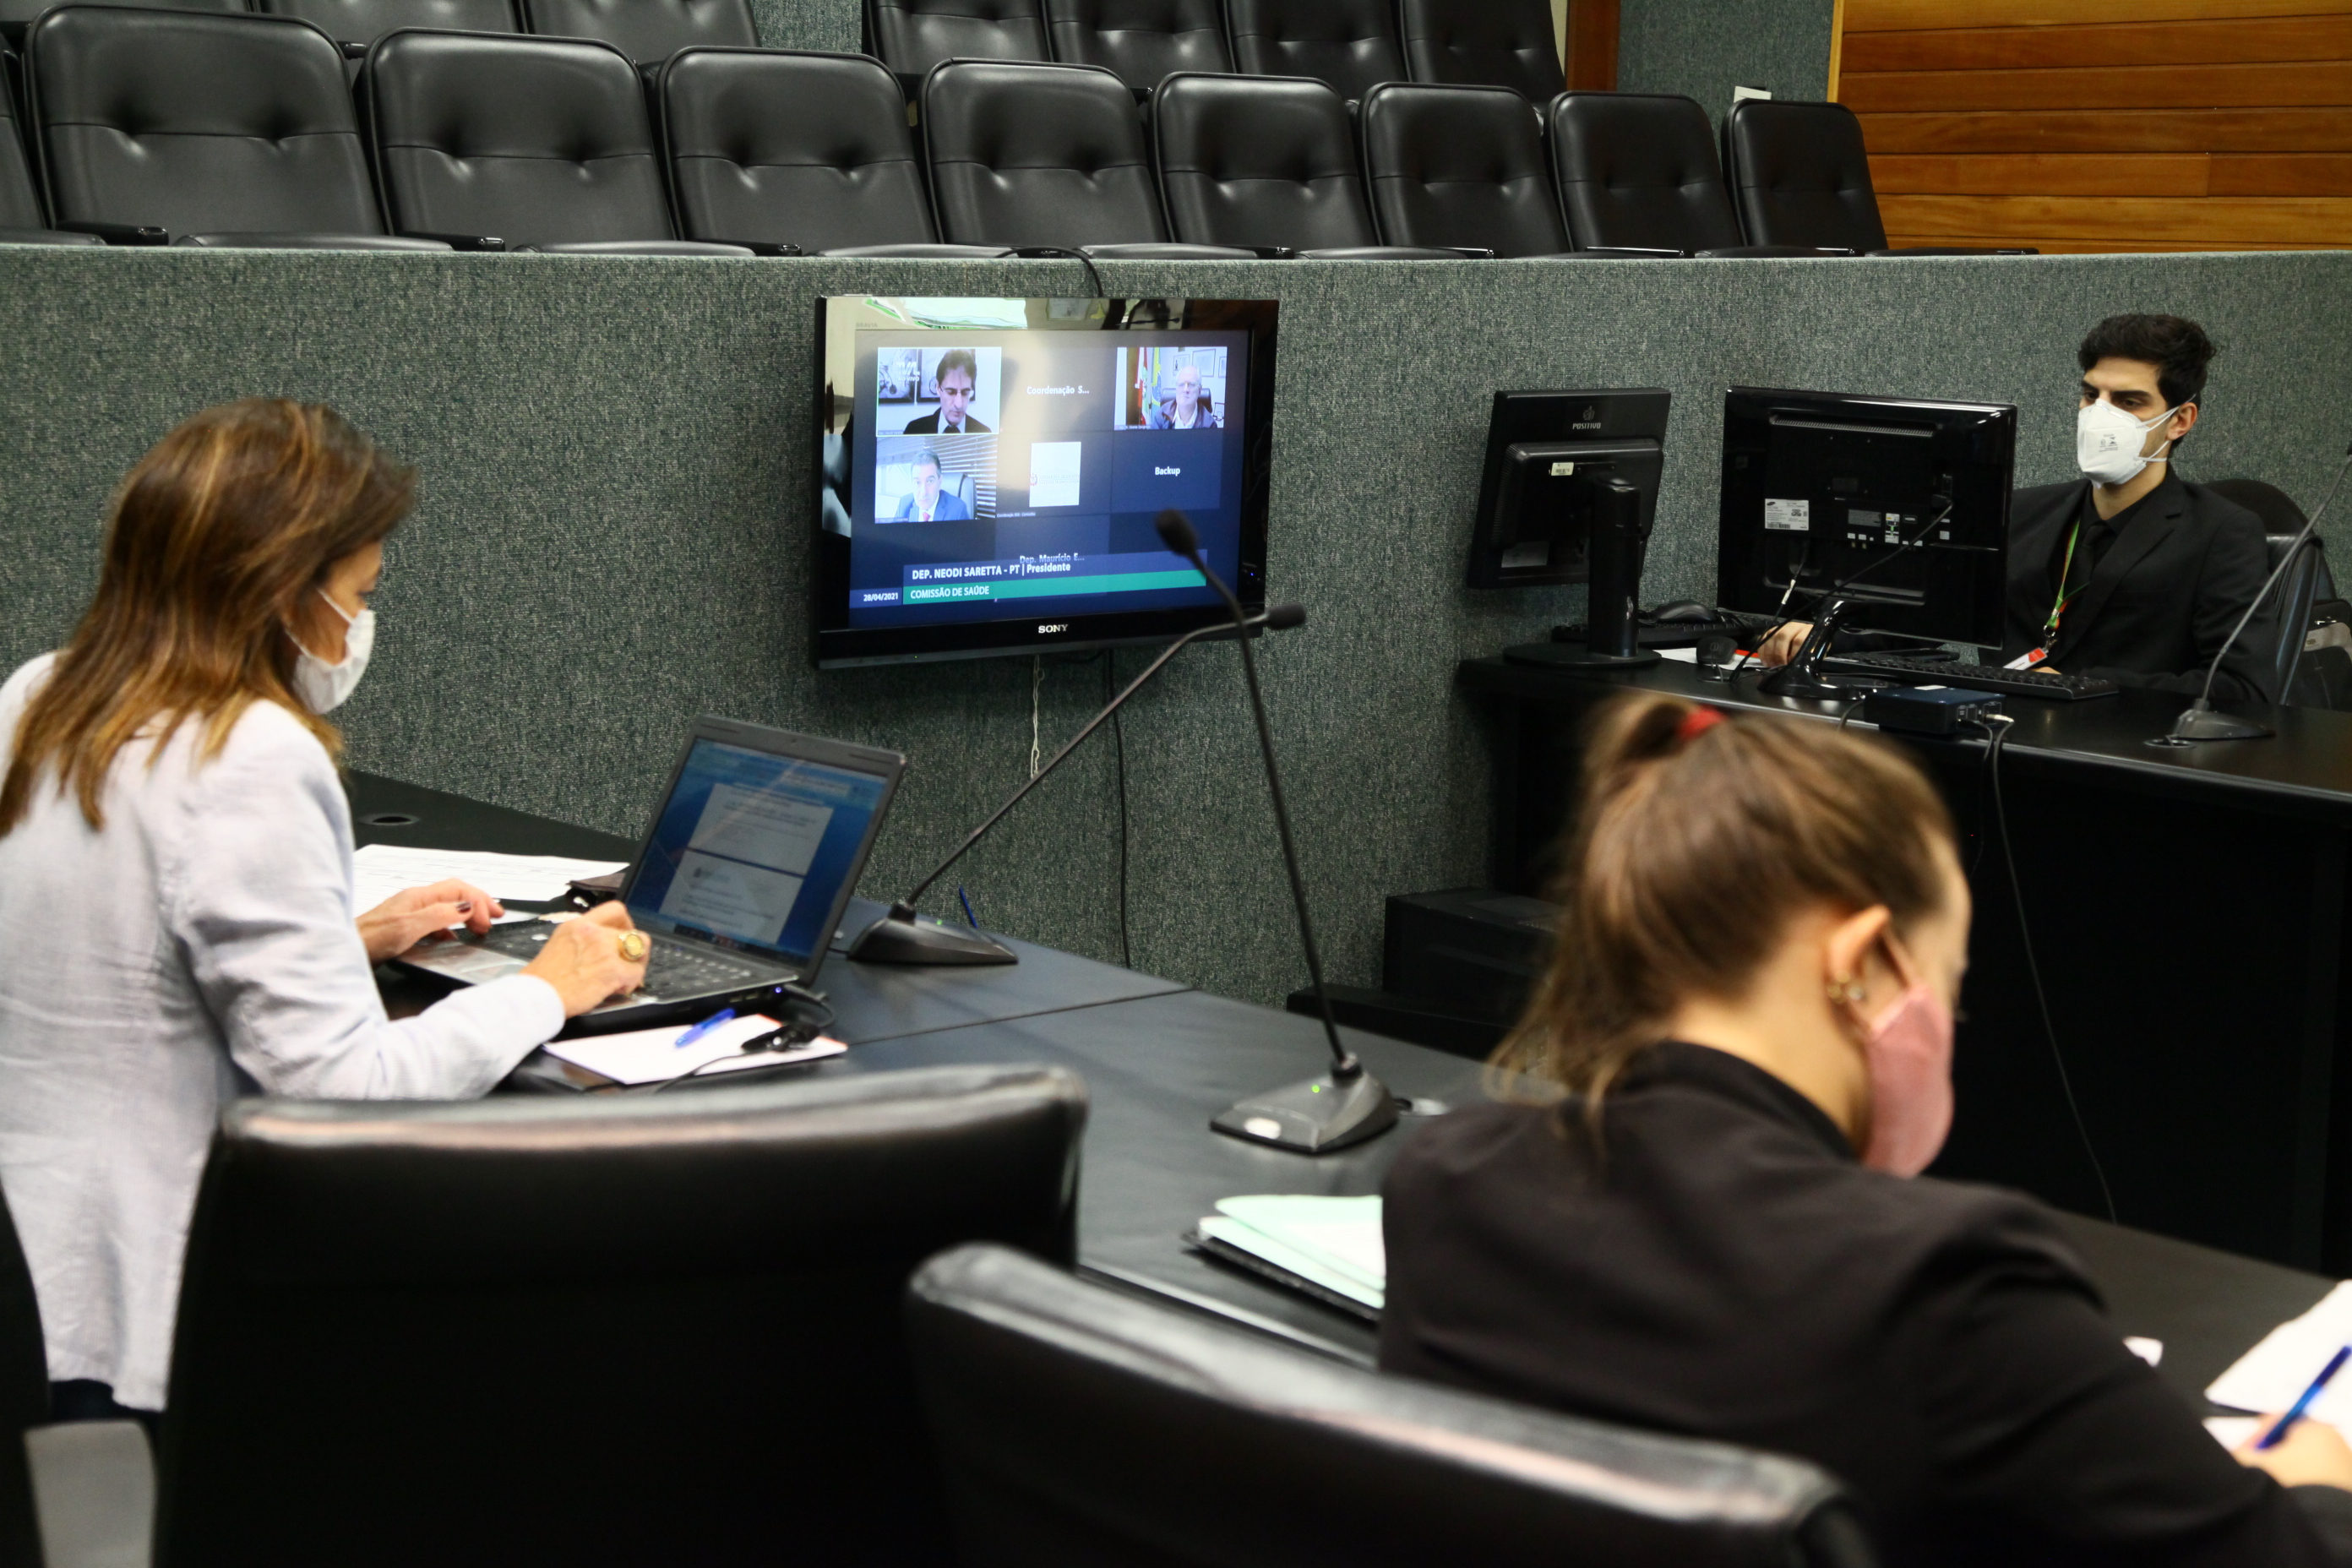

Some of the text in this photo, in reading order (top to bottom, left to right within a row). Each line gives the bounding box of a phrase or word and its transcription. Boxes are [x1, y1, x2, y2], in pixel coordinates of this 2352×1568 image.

[1026, 386, 1075, 395] Coordenação
[1154, 466, 1181, 476] Backup
[1020, 555, 1037, 564] Dep.
[1039, 553, 1071, 563] Maurício
[912, 569, 933, 580] DEP.
[934, 568, 962, 579] NEODI
[964, 565, 1003, 577] SARETTA
[1009, 564, 1021, 574] PT
[1026, 563, 1071, 574] Presidente
[863, 592, 899, 602] 28/04/2021
[910, 585, 989, 599] COMISSÃO DE SAÚDE
[1038, 624, 1069, 634] SONY
